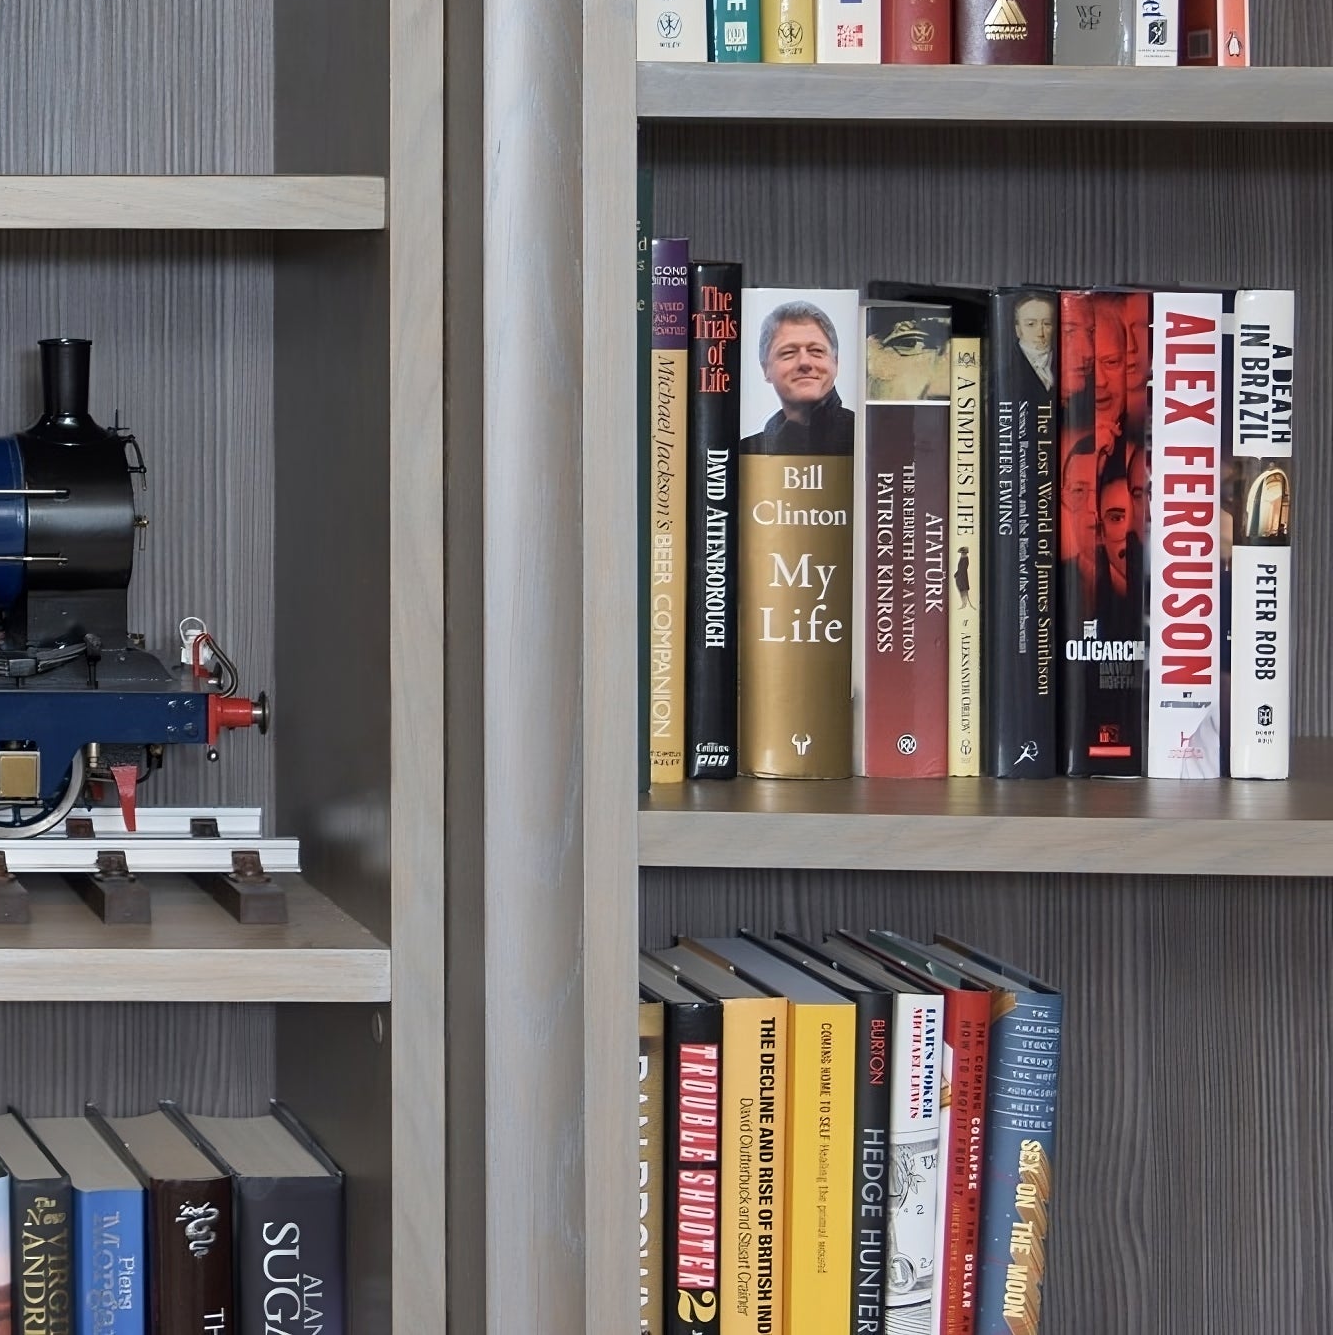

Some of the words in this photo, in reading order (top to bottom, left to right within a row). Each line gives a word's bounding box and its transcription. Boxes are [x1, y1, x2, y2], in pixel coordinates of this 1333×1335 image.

[701, 285, 733, 312] The
[691, 313, 738, 339] Trials
[1240, 323, 1271, 347] IN
[1272, 344, 1293, 359] A
[707, 340, 727, 366] of
[1164, 311, 1216, 426] ALEX
[657, 355, 676, 435] Michael
[698, 366, 731, 393] Life
[957, 376, 976, 391] A
[1239, 356, 1270, 445] BRAZIL
[1037, 400, 1052, 433] The
[1271, 368, 1293, 444] DEATH
[957, 397, 975, 485] SIMPLES
[998, 401, 1013, 475] HEATHER
[1037, 440, 1052, 476] Lost
[652, 434, 675, 531] Jackson's
[706, 448, 729, 501] DAVID
[782, 464, 824, 490] Bill
[902, 463, 916, 495] THE
[752, 499, 847, 526] Clinton
[877, 472, 894, 558] PATRICK
[902, 497, 915, 561] REBIRTH
[956, 491, 976, 537] LIFE
[998, 479, 1013, 536] EWING
[1037, 481, 1053, 534] World
[654, 533, 673, 586] BEER
[924, 512, 946, 614] ATATÜRK
[1037, 538, 1052, 557] of
[1161, 446, 1215, 685] FERGUSON
[705, 505, 729, 649] ATTENBOROUGH
[767, 552, 837, 601] My
[902, 565, 915, 585] OF
[903, 588, 915, 599] A
[1035, 561, 1053, 613] James
[1255, 563, 1278, 622] PETER
[758, 604, 844, 643] Life
[877, 564, 894, 653] KINROSS
[902, 603, 916, 663] NATION
[652, 594, 673, 738] COMPANION
[1037, 618, 1052, 696] Smithson
[1254, 630, 1277, 681] ROBB
[760, 1016, 776, 1050] THE
[869, 1019, 886, 1085] BURTON
[911, 1007, 923, 1071] MICHAEL
[925, 1008, 937, 1060] LIAR'S
[680, 1045, 718, 1161] TROUBLE
[739, 1097, 754, 1132] David
[759, 1053, 775, 1124] DECLINE
[819, 1100, 831, 1113] TO
[910, 1074, 921, 1119] LEWIS
[922, 1064, 934, 1119] POKER
[759, 1127, 774, 1163] AND
[819, 1116, 831, 1140] SELF
[969, 1117, 981, 1190] COLLAPSE
[861, 1128, 885, 1217] HEDGE
[1018, 1138, 1042, 1174] SEX
[758, 1167, 774, 1206] RISE
[1015, 1182, 1037, 1209] ON
[678, 1171, 715, 1287] SHOOTER
[738, 1206, 750, 1230] and
[758, 1209, 773, 1231] OF
[1009, 1220, 1034, 1256] THE
[738, 1232, 752, 1269] Stuart
[757, 1234, 773, 1301] BRITISH
[118, 1256, 136, 1310] Piers
[677, 1288, 717, 1323] 2
[857, 1229, 882, 1335] HUNTER
[961, 1254, 974, 1308] DOLLAR
[1002, 1263, 1029, 1318] MOON
